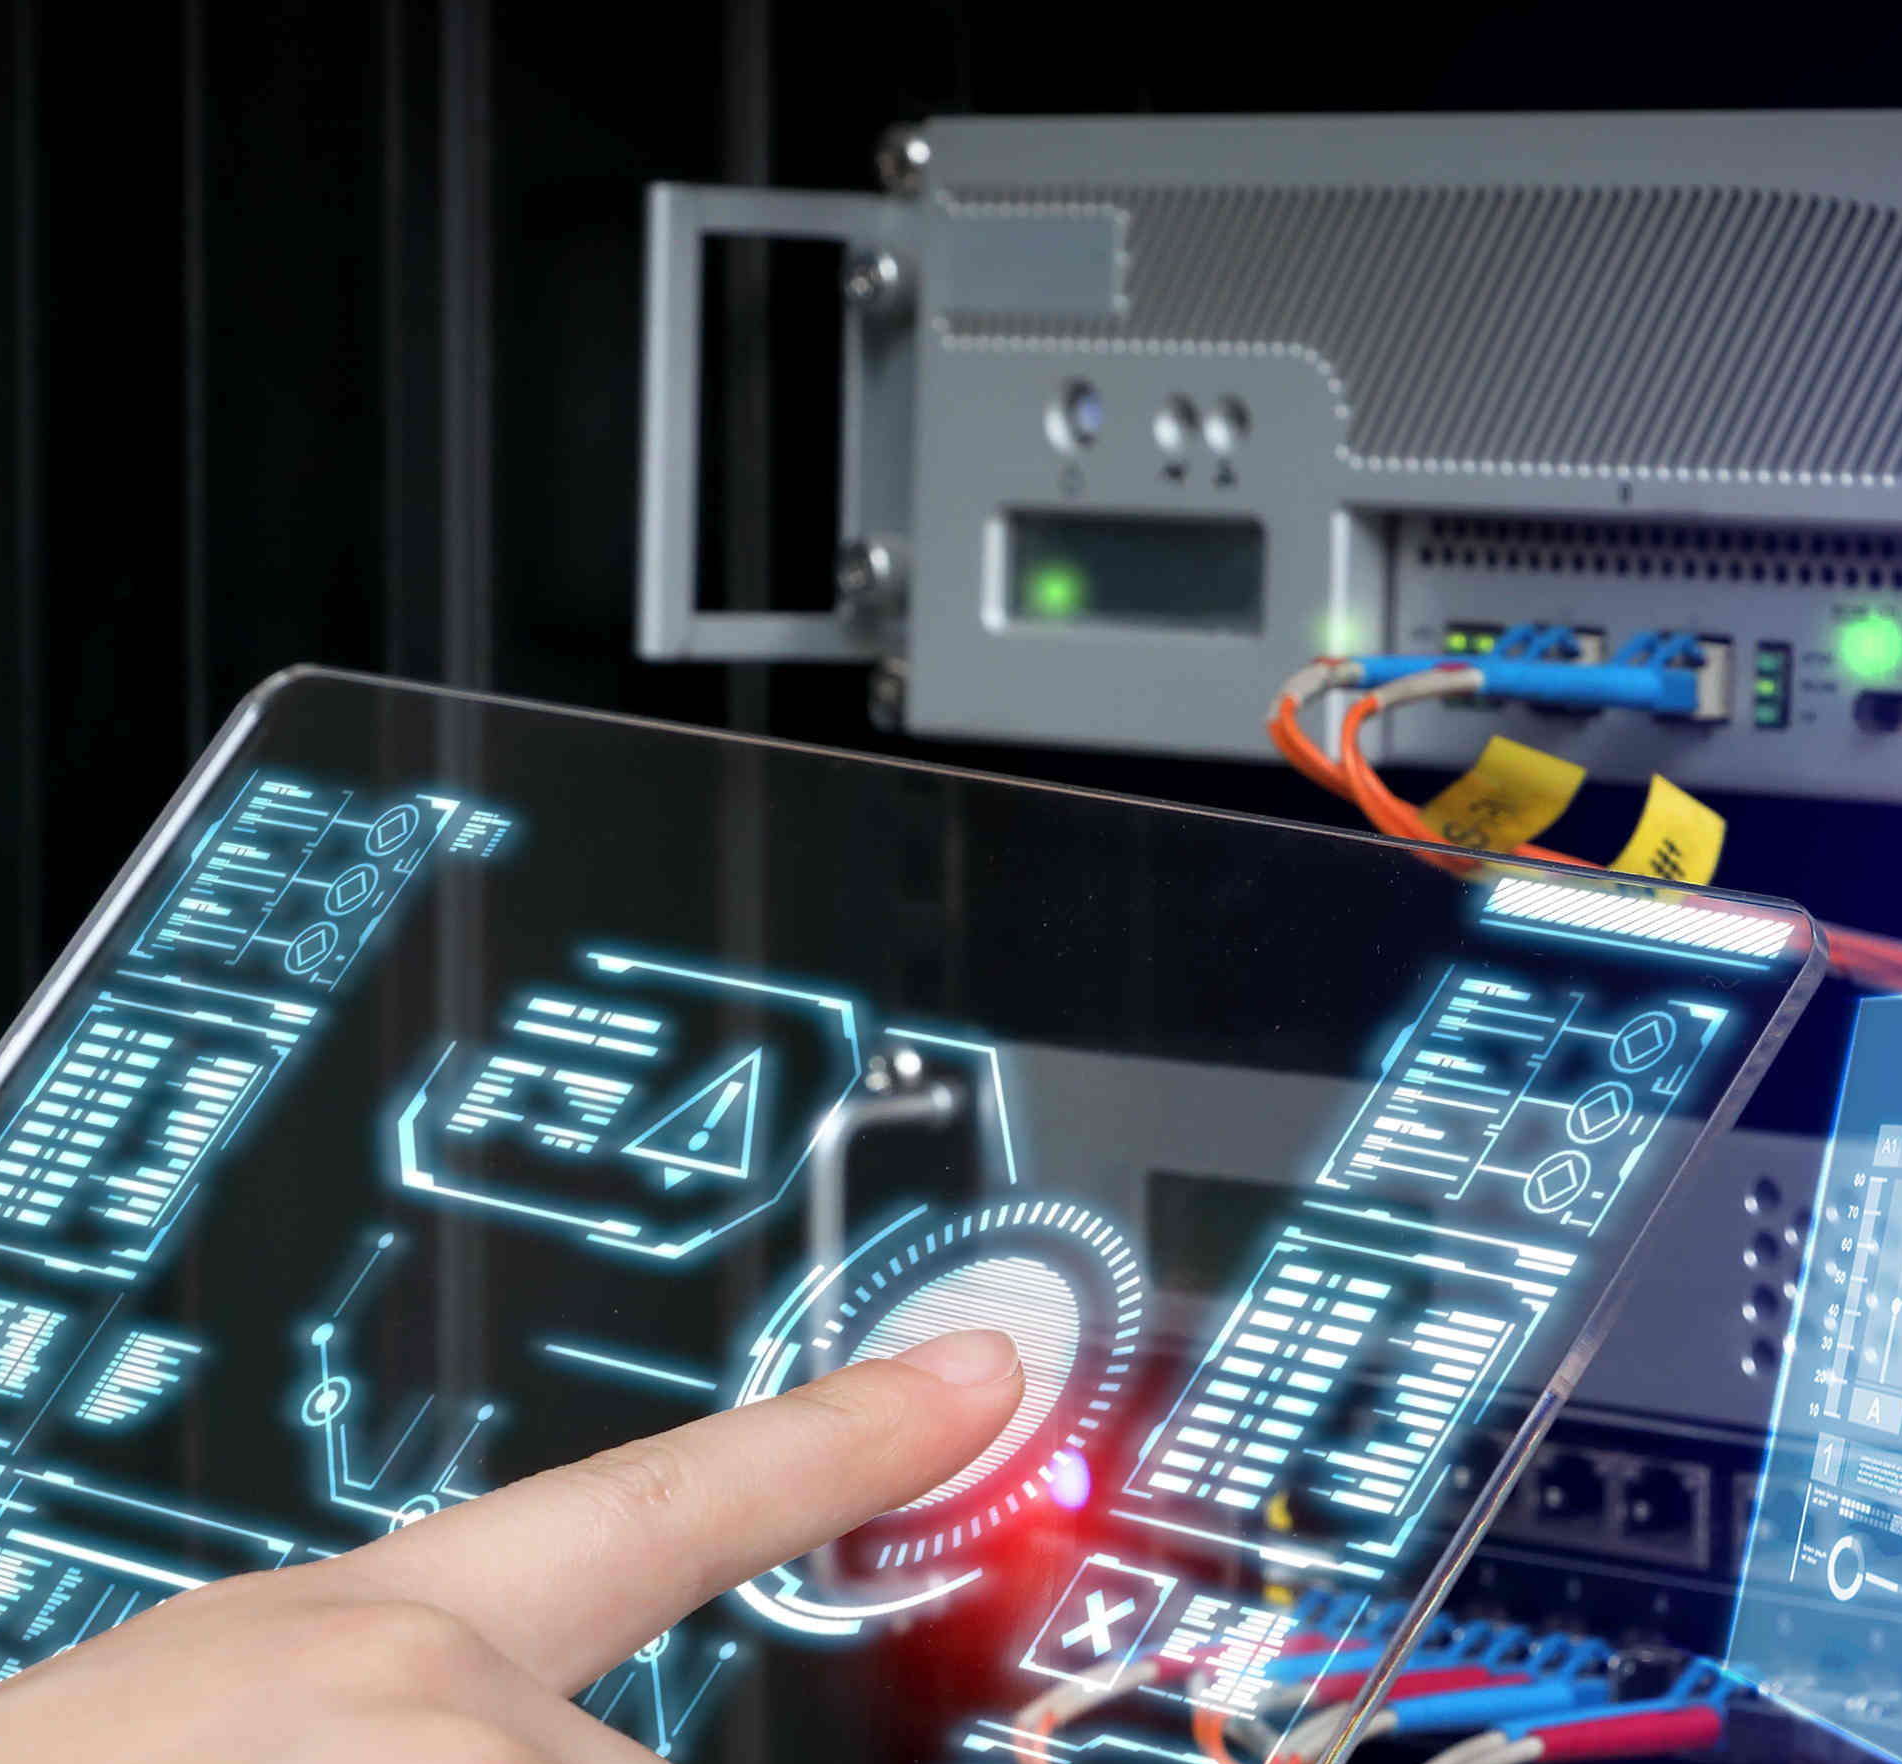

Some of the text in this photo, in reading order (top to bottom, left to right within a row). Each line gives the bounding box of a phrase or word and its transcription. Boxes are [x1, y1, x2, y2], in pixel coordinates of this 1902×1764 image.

[1881, 1138, 1898, 1154] A1
[1847, 1206, 1859, 1219] 70
[1841, 1238, 1853, 1252] 60
[1828, 1303, 1840, 1318] 40
[1821, 1336, 1833, 1351] 30
[1866, 1397, 1881, 1425] A
[1823, 1441, 1834, 1476] 1
